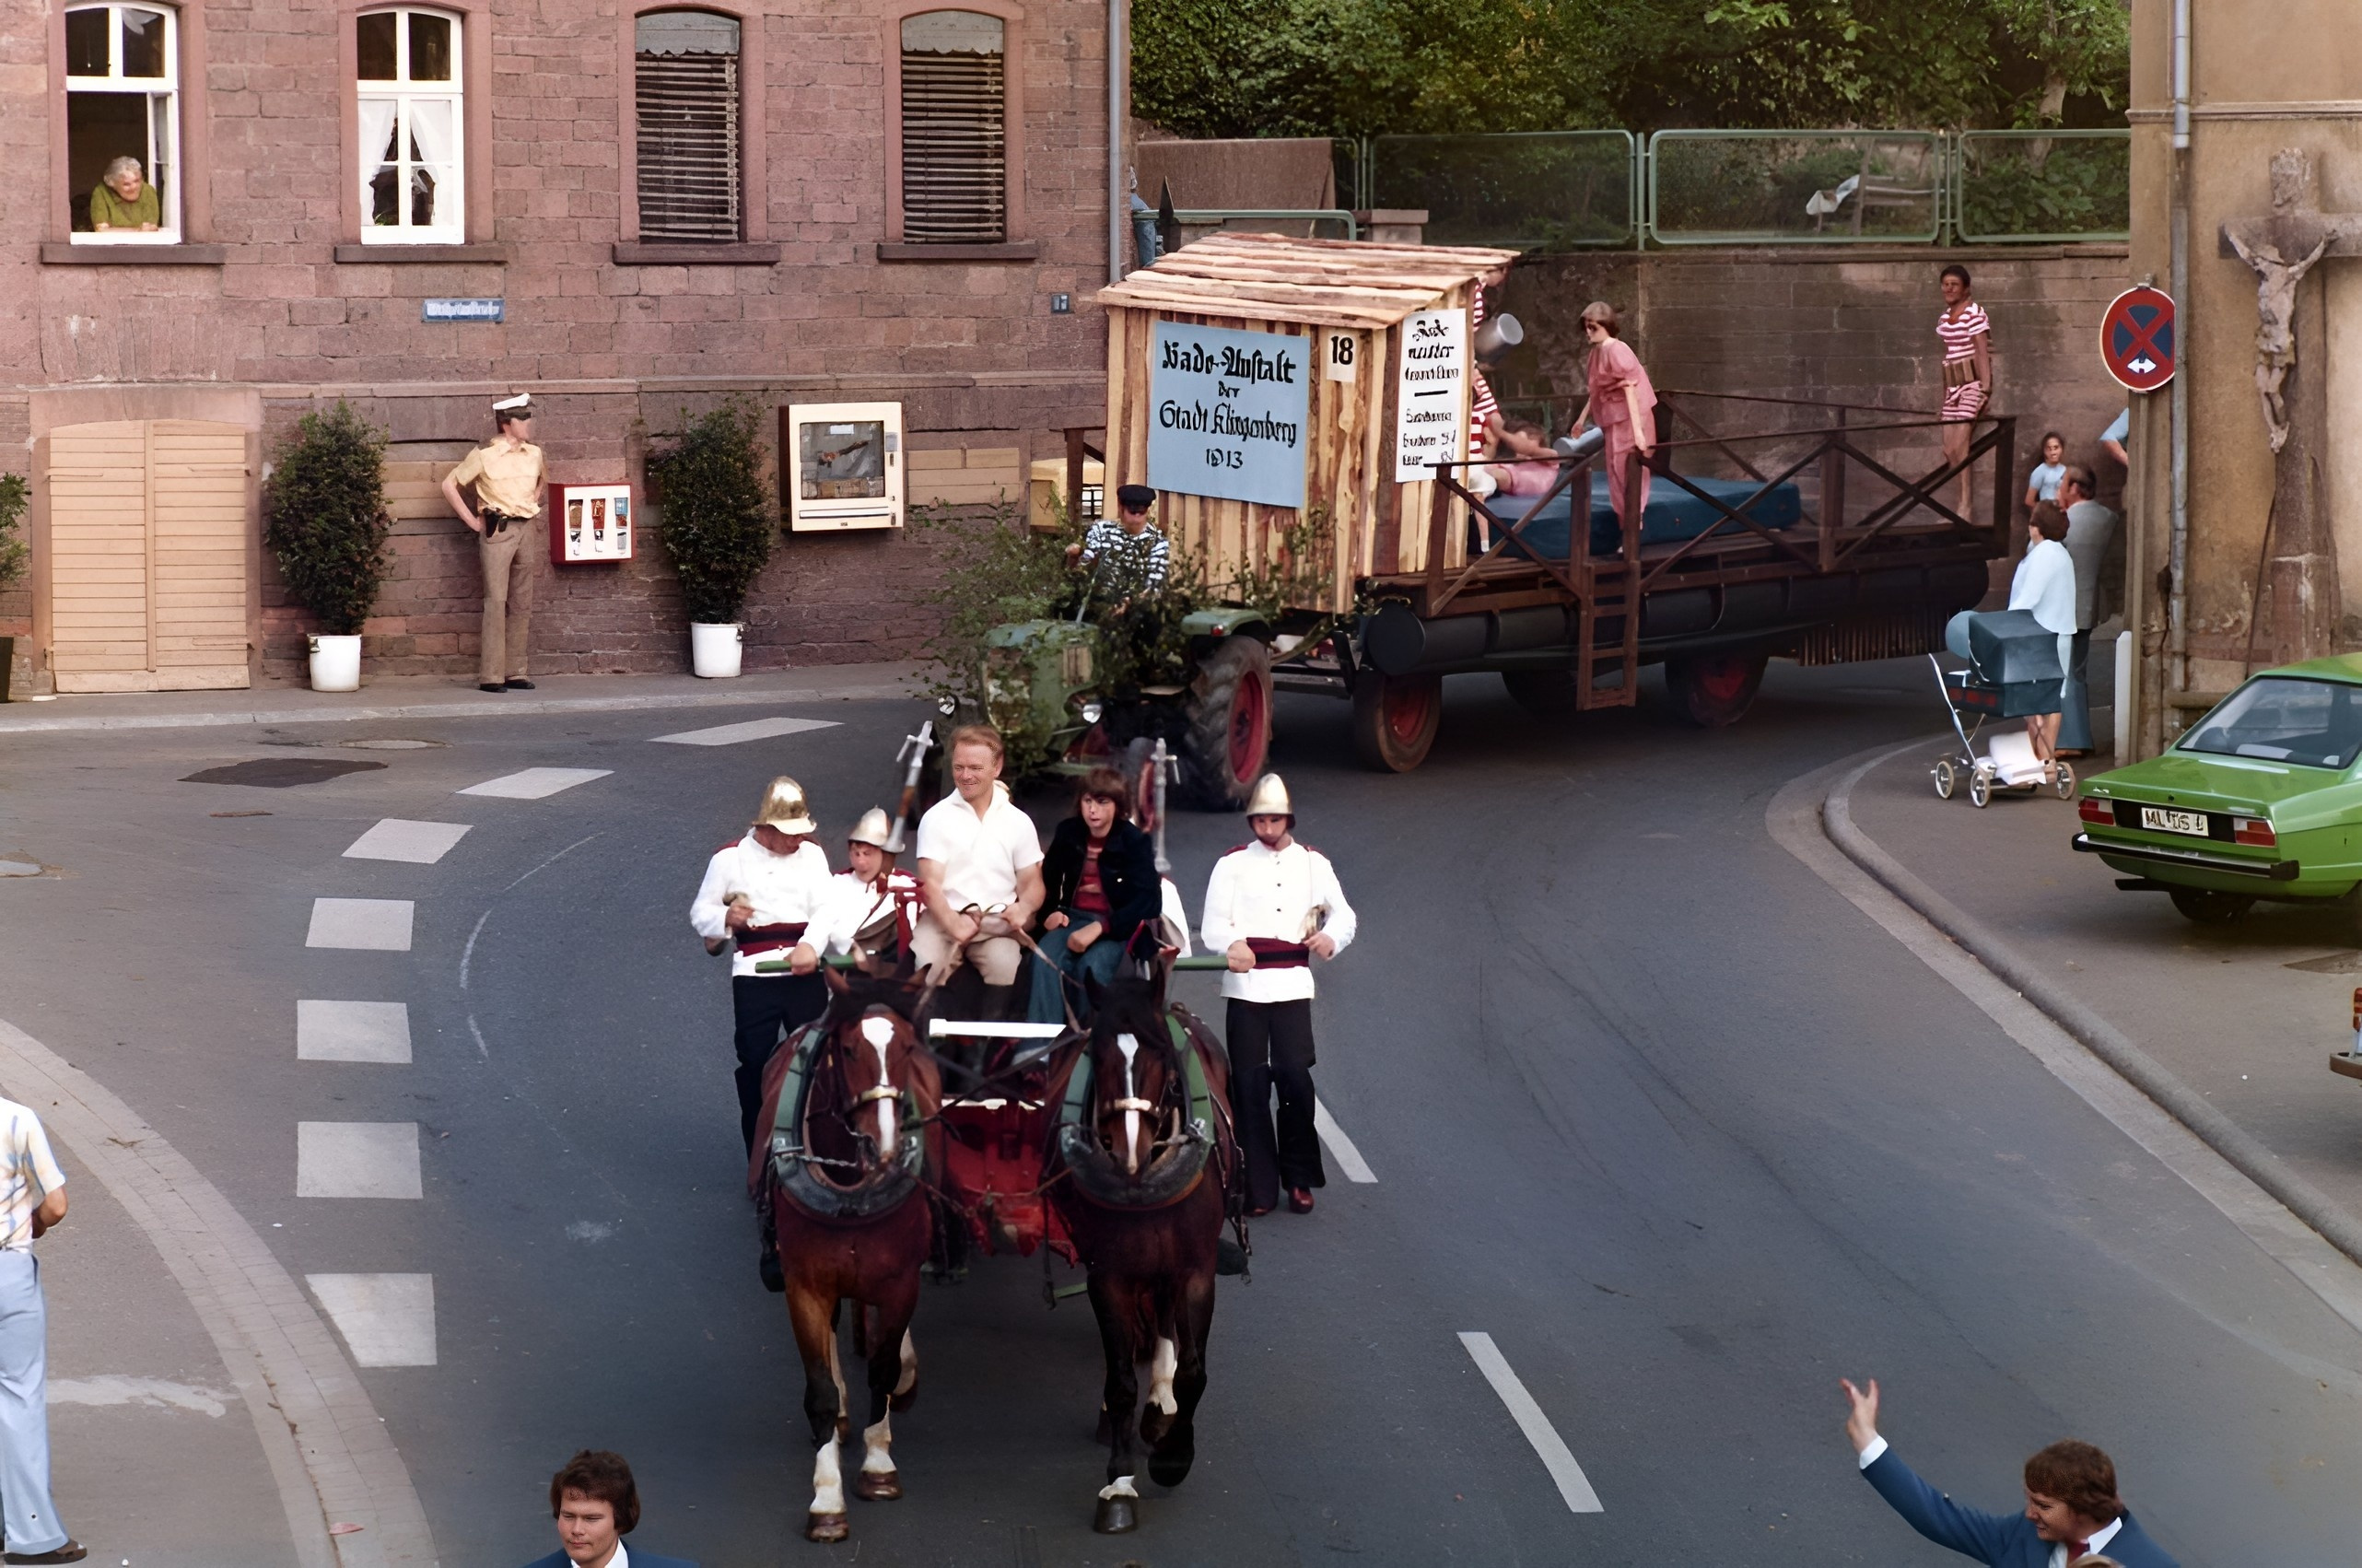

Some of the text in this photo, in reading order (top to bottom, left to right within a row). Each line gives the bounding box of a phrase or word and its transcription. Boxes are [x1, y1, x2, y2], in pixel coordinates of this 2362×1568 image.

[1330, 335, 1354, 365] 18
[1159, 399, 1297, 449] Stadt Klingenberg
